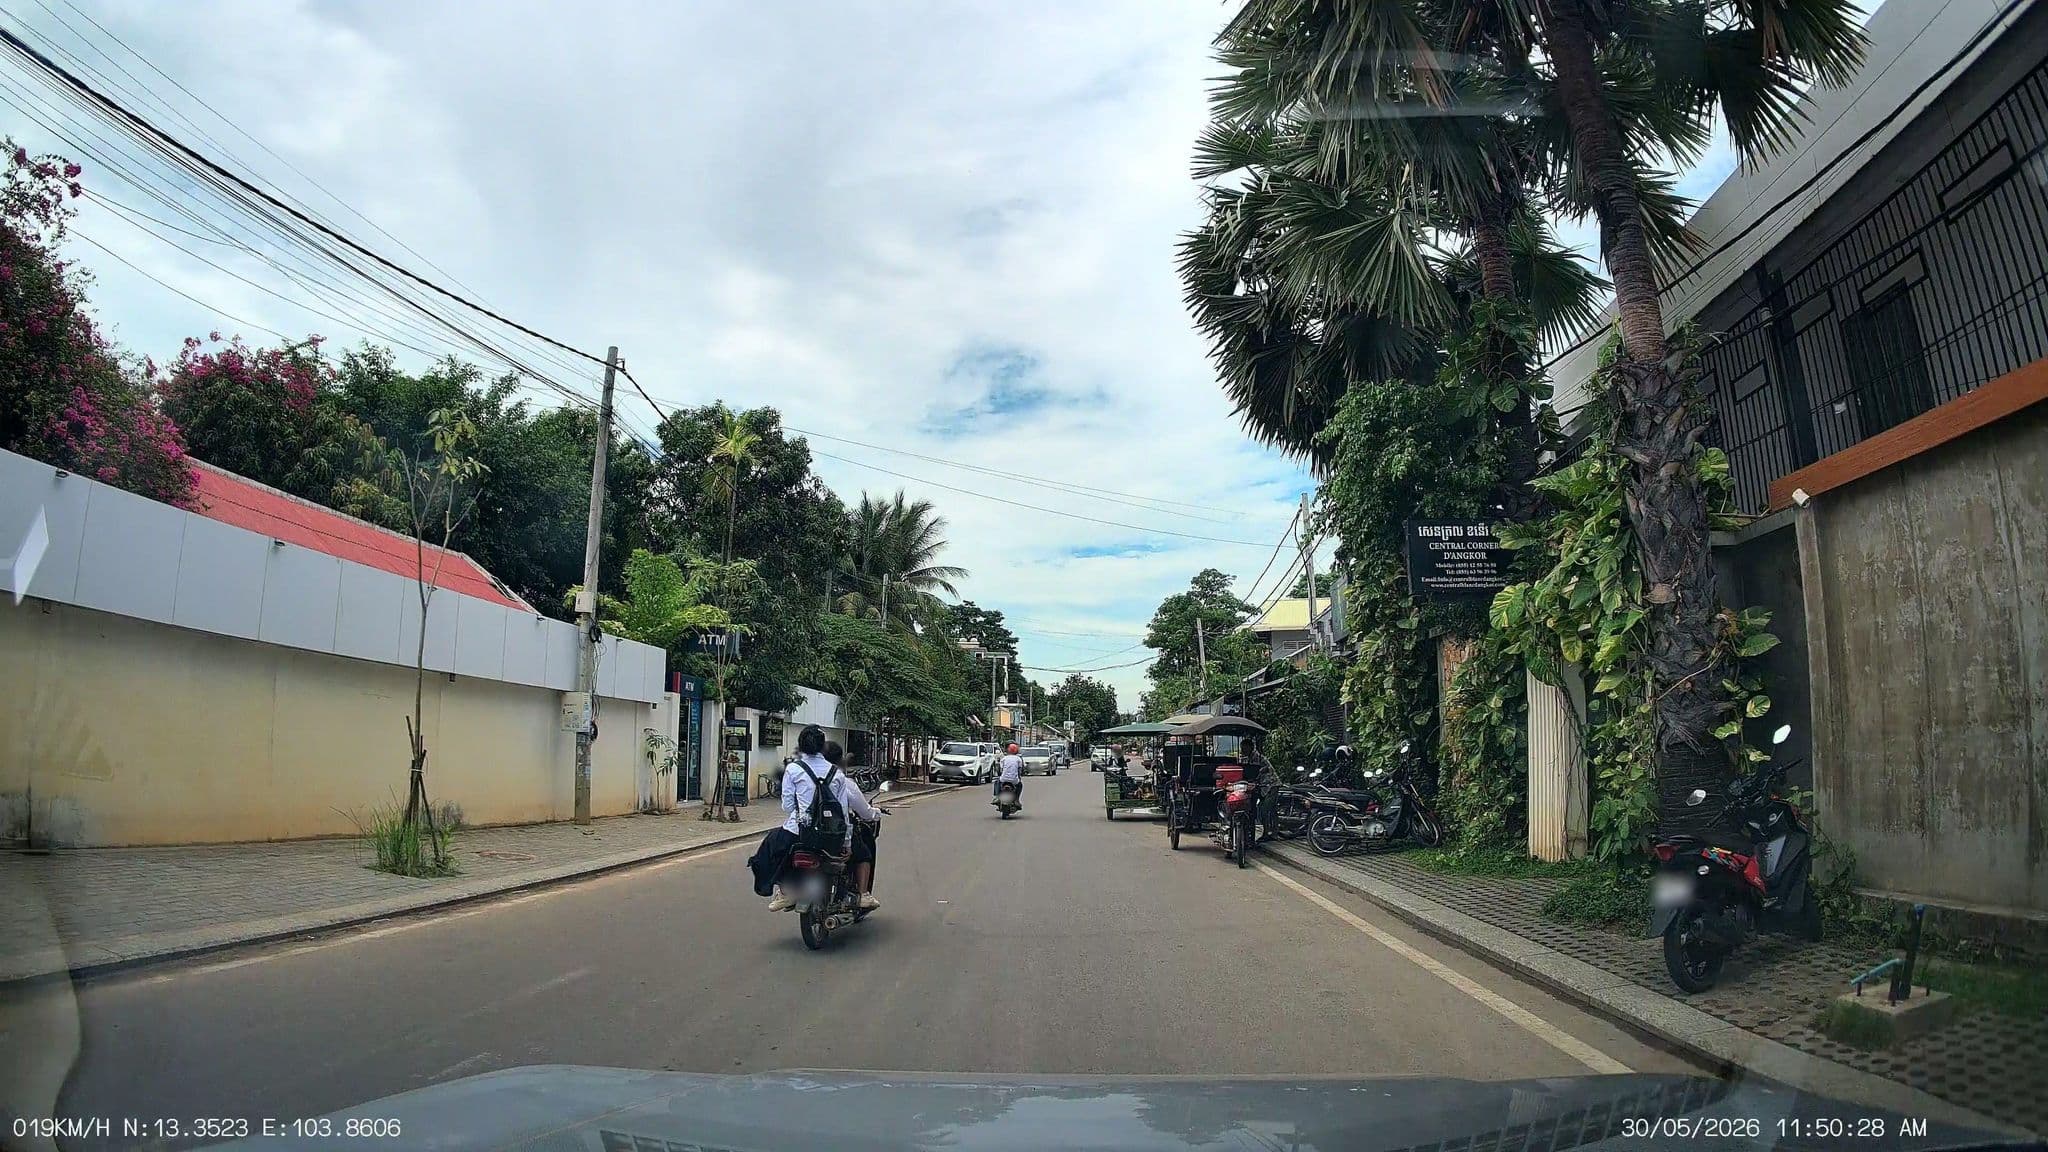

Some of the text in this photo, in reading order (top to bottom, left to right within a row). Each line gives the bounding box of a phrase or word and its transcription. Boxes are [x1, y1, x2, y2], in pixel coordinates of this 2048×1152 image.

[1429, 542, 1499, 550] CENTRAL CORNER
[1444, 551, 1487, 560] D'ANGKOR
[698, 633, 727, 646] ATM
[685, 682, 694, 692] ATM
